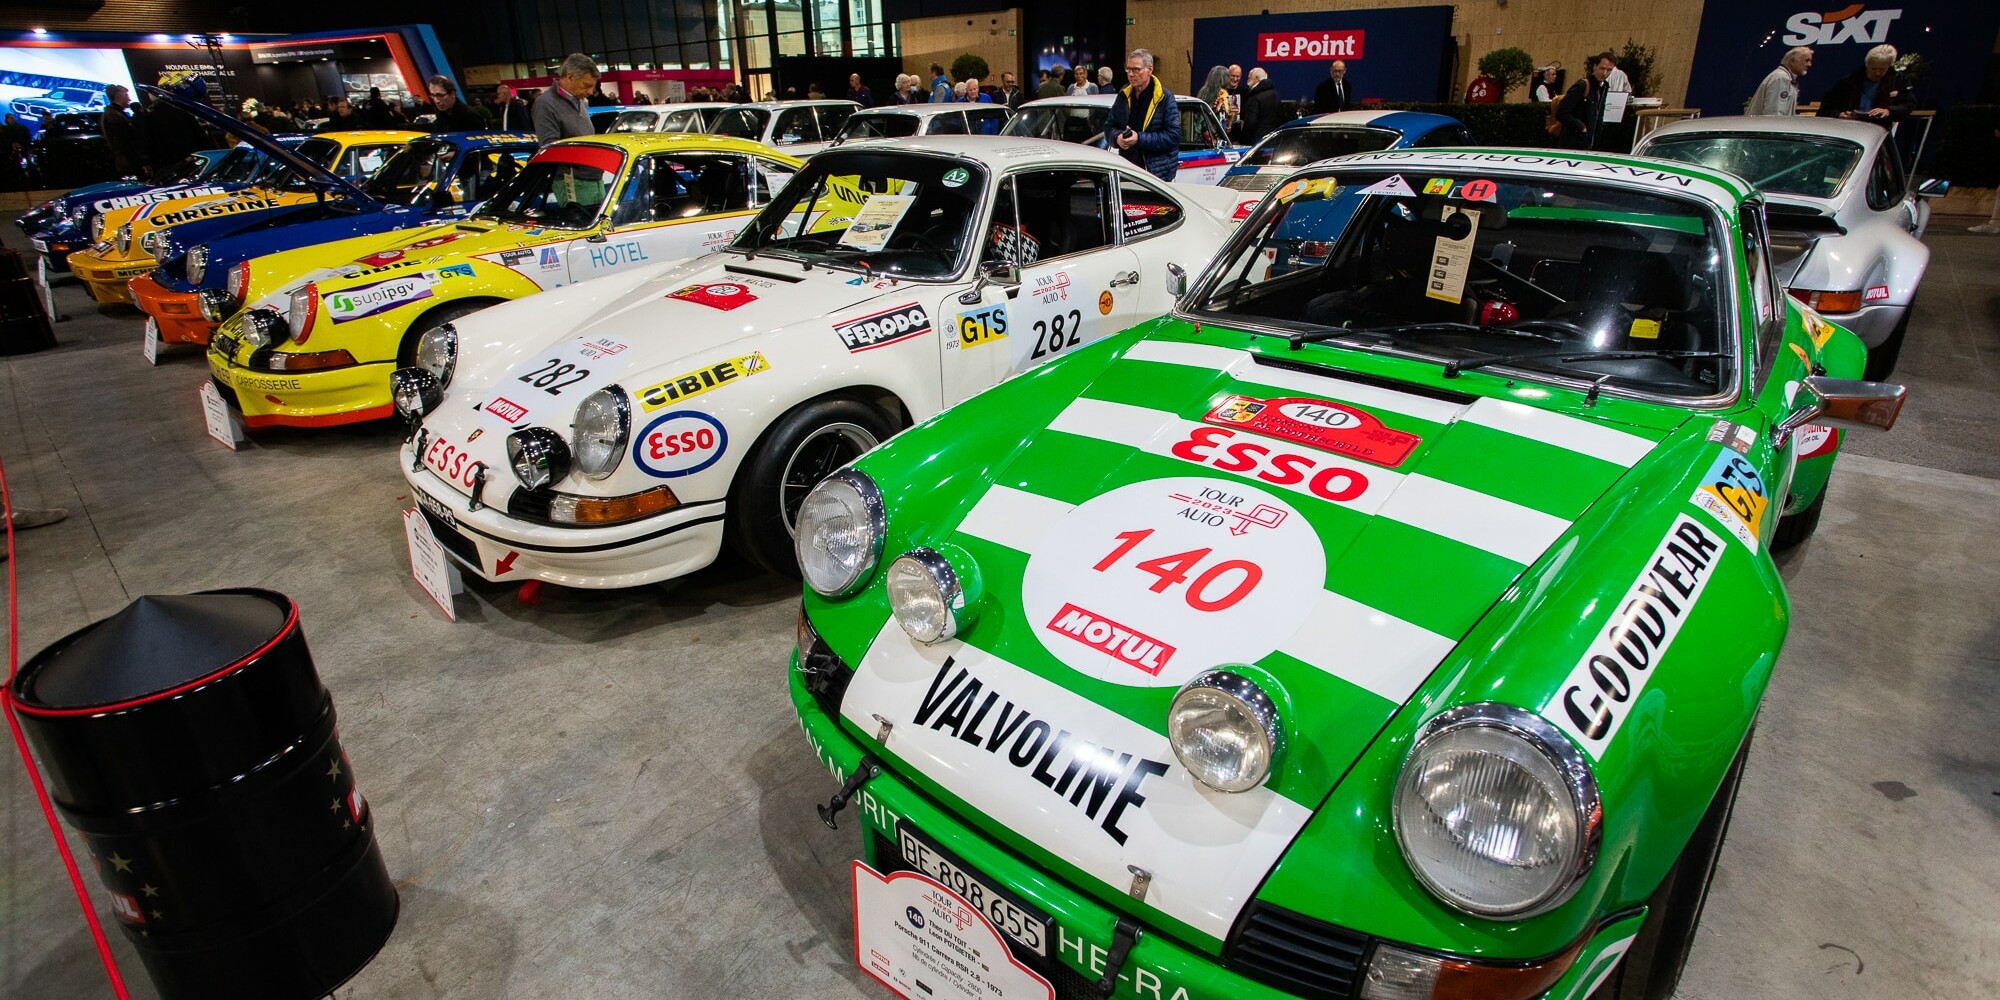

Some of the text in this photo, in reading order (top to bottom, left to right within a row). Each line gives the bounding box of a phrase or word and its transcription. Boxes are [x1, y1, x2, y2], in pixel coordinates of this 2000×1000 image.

[1265, 34, 1355, 57] Le Point
[1423, 153, 1582, 168] MORITZ
[944, 170, 966, 183] A2
[1595, 163, 1692, 187] MAX
[94, 187, 225, 213] CHRISTINE
[1468, 183, 1489, 198] H
[150, 199, 281, 228] CHRISTINE
[590, 242, 648, 269] HOTEL
[440, 265, 473, 279] GTS
[1036, 275, 1054, 287] TOUR
[1041, 286, 1056, 294] 2023
[1042, 292, 1059, 305] AUTO
[1866, 287, 1889, 299] MOTUL
[838, 309, 925, 346] FERODO
[961, 308, 1007, 344] GTS
[1031, 309, 1082, 360] 282
[946, 340, 960, 350] 1973
[236, 374, 302, 391] CARROSSERIE
[518, 358, 591, 396] 282
[489, 400, 521, 421] MOTUL
[1295, 405, 1350, 428] 140
[649, 428, 714, 461] ESSO
[428, 437, 480, 488] ESSO
[1171, 427, 1369, 501] ESSO
[1199, 487, 1244, 507] TOUR
[1715, 457, 1763, 523] GTS
[1177, 507, 1225, 527] AUTO
[1192, 499, 1232, 515] 2023
[1093, 528, 1263, 612] 140
[1055, 610, 1166, 668] MOTUL
[1563, 521, 1718, 741] GOODYEAR
[913, 655, 1170, 847] VALVOLINE
[932, 890, 952, 908] TOUR
[907, 910, 923, 926] 140
[932, 907, 952, 923] AUTO
[990, 899, 1040, 949] 655
[929, 920, 943, 932] Theo
[944, 929, 952, 939] DU
[954, 935, 967, 948] TOIT
[929, 928, 943, 942] Leon
[944, 938, 976, 963] POTGIETER
[894, 920, 918, 940] Porsche
[919, 936, 930, 948] 911
[931, 945, 955, 966] Carrera
[956, 960, 969, 975] RSR
[970, 970, 981, 982] 2.8
[987, 981, 1003, 997] 1973
[967, 980, 982, 995] 2800
